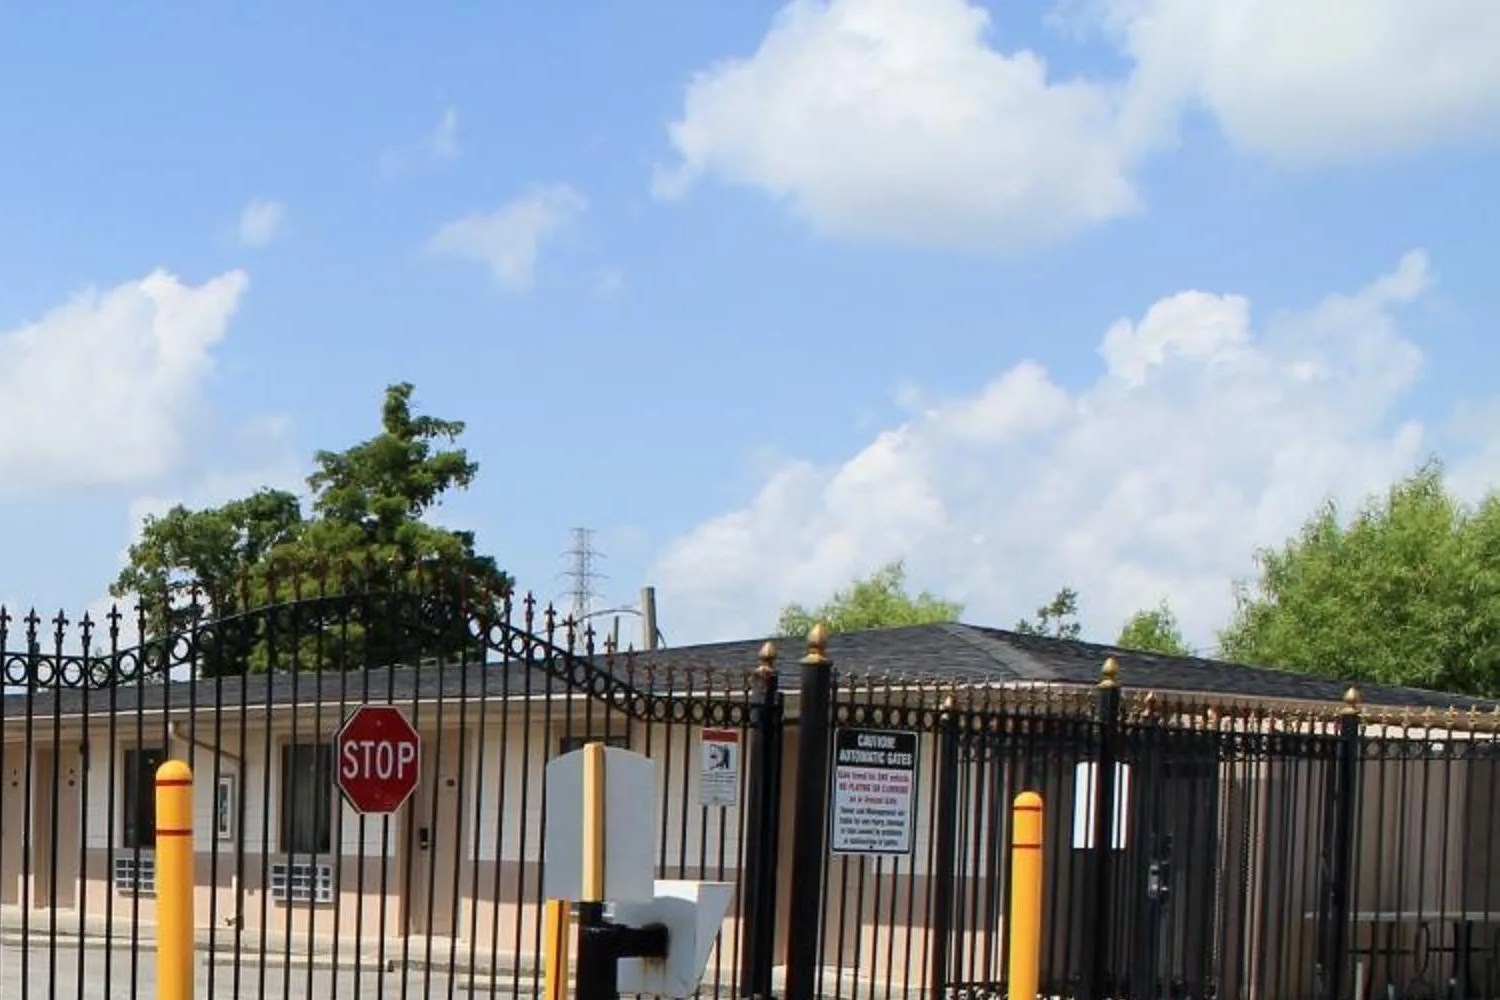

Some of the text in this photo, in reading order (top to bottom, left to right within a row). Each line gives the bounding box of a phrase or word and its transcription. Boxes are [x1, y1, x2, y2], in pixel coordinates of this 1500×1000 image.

[342, 741, 415, 779] STOP
[840, 749, 912, 765] AUTOMATIC GATES
